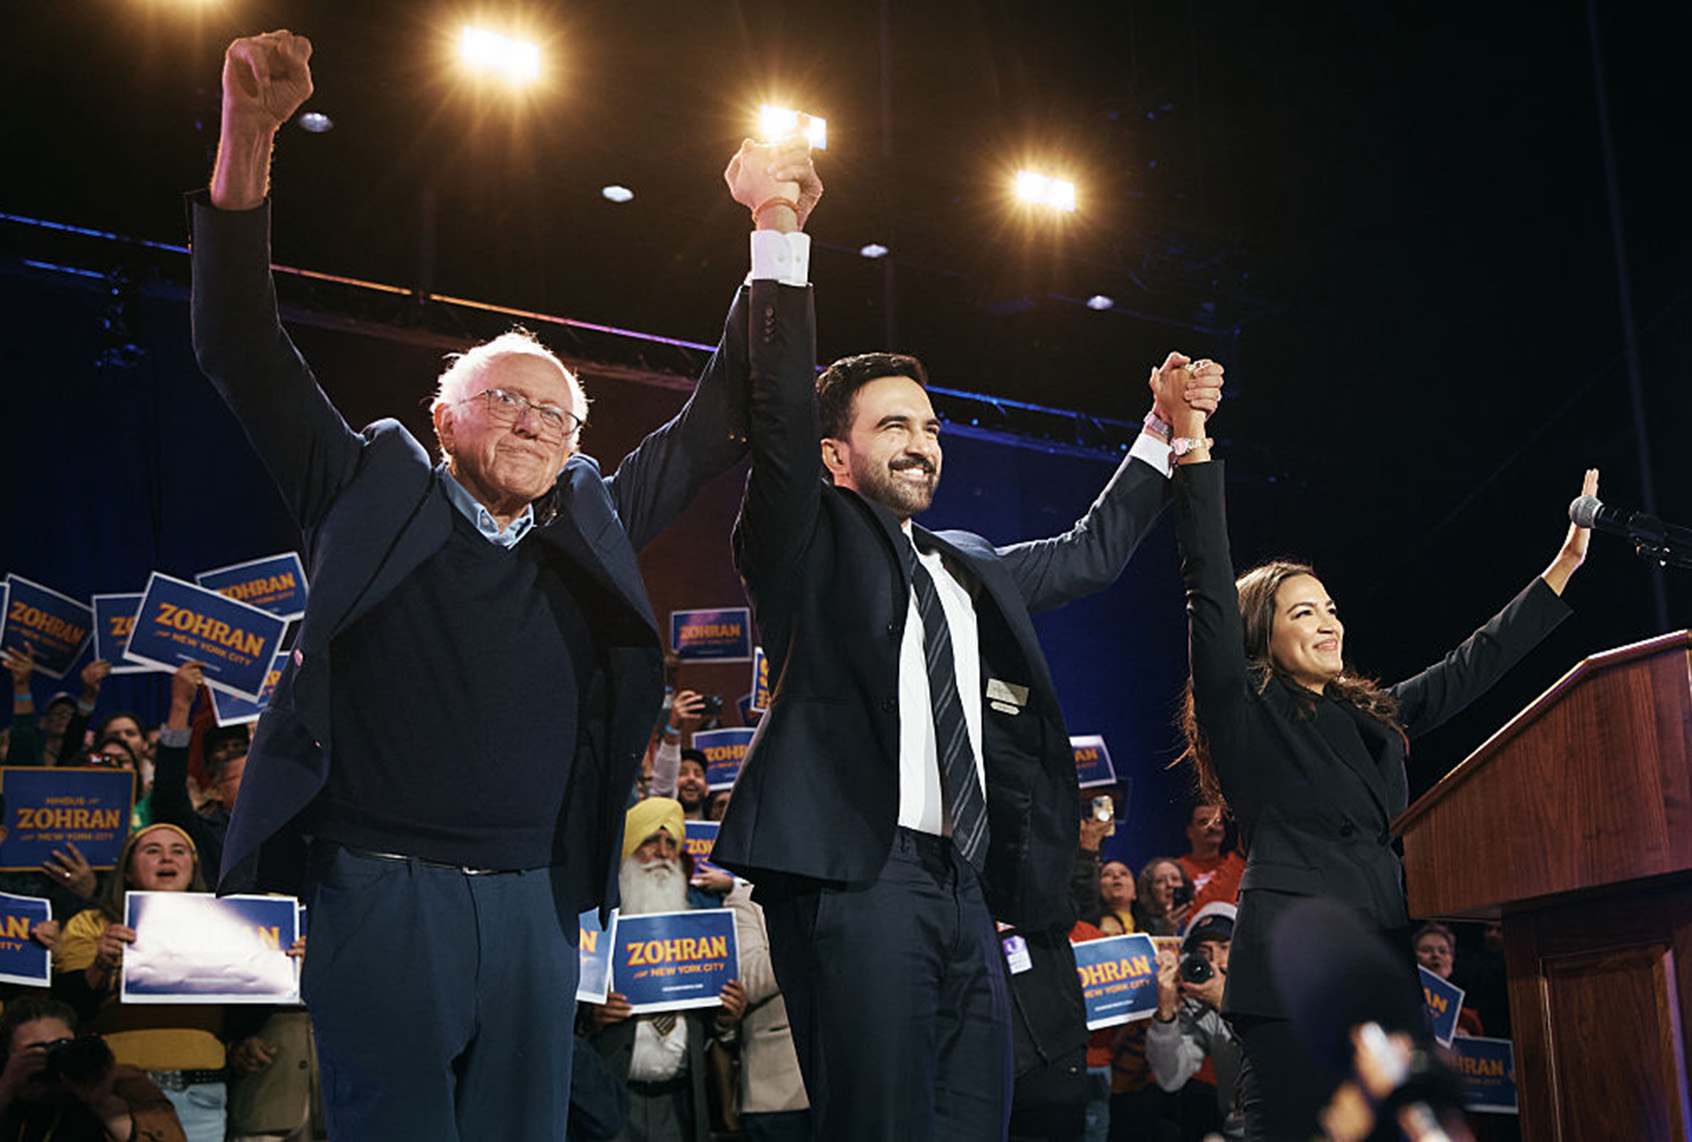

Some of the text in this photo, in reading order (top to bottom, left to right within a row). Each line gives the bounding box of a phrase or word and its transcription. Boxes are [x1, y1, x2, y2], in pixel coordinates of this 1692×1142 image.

[9, 601, 85, 645] ZOHRAN
[154, 602, 265, 657] ZOHRAN
[679, 624, 741, 640] ZOHRAN
[172, 629, 198, 647] NEW
[16, 807, 120, 830] ZOHRAN
[626, 936, 728, 966] ZOHRAN
[650, 966, 677, 977] NEW
[678, 964, 702, 974] YORK
[703, 962, 725, 973] CITY
